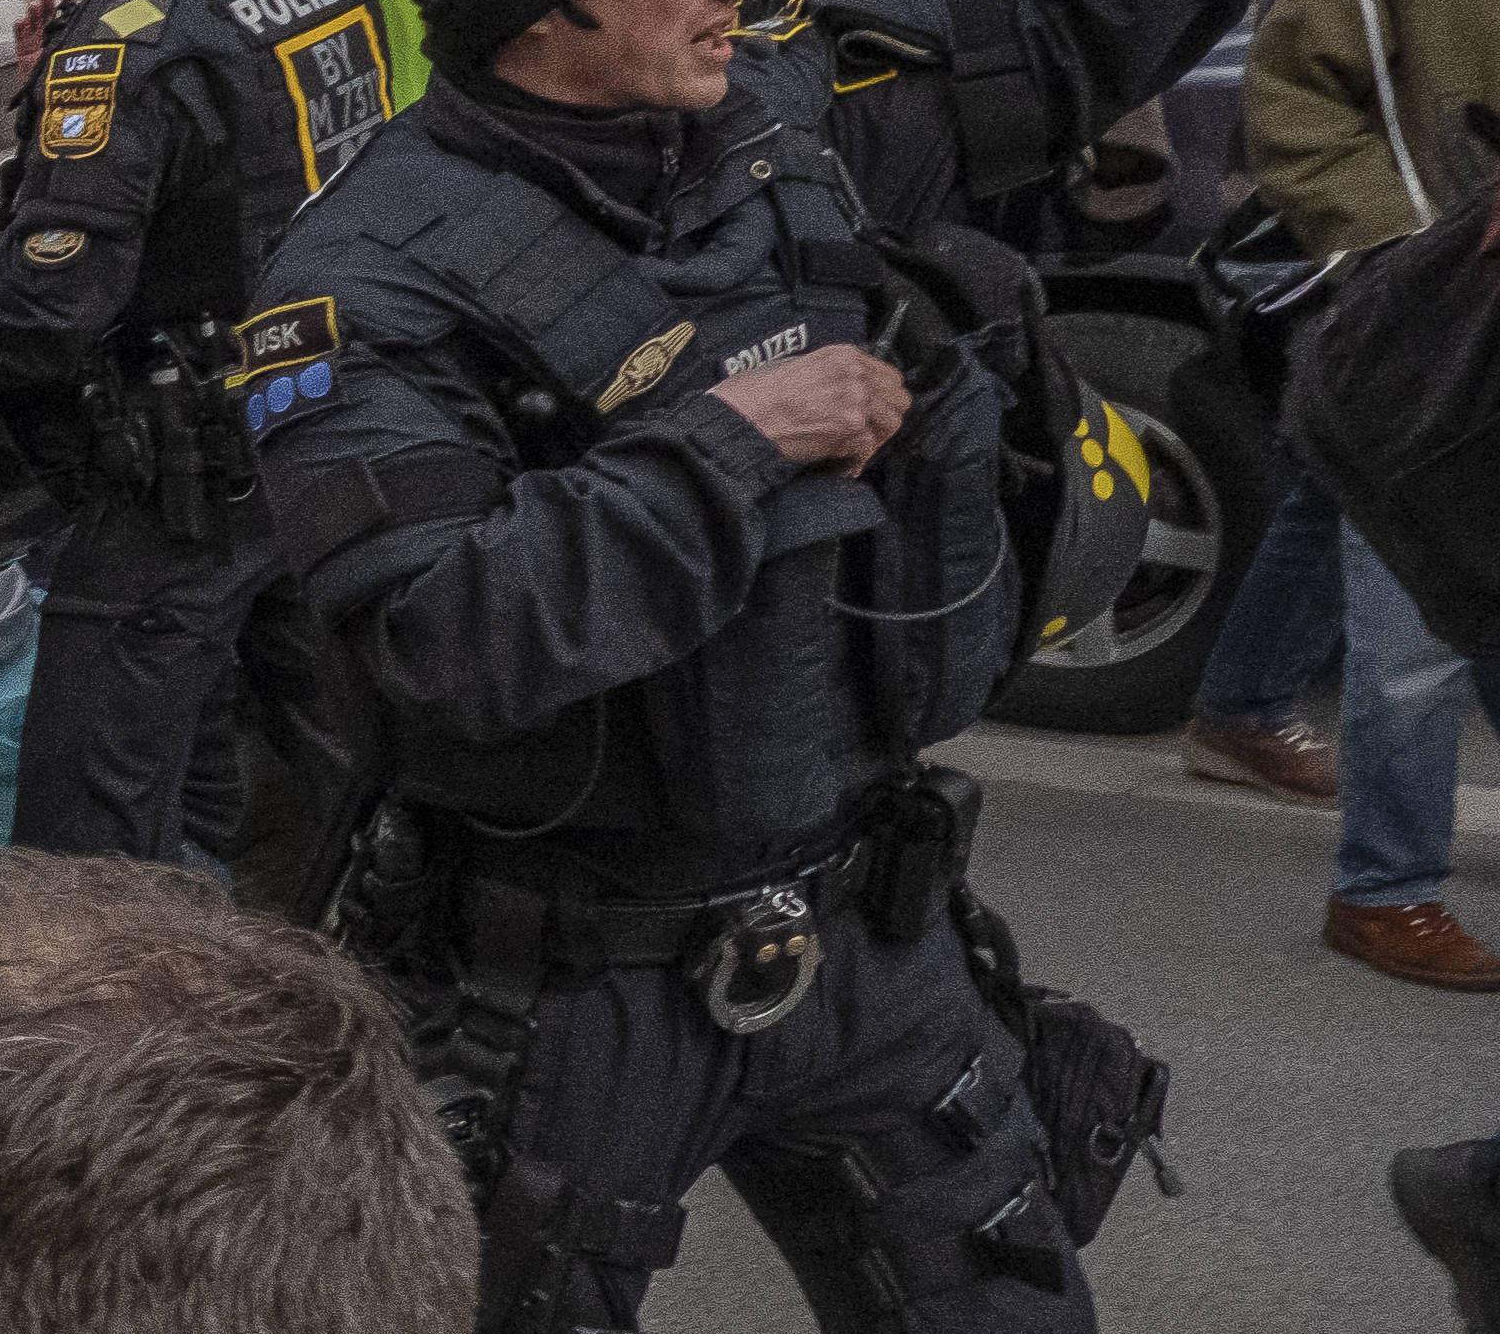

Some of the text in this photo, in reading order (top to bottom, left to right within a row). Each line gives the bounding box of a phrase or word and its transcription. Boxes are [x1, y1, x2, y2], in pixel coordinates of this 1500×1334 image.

[64, 53, 101, 73] USK
[311, 32, 354, 87] BY
[51, 87, 110, 103] POLIZEI
[252, 321, 302, 357] USK
